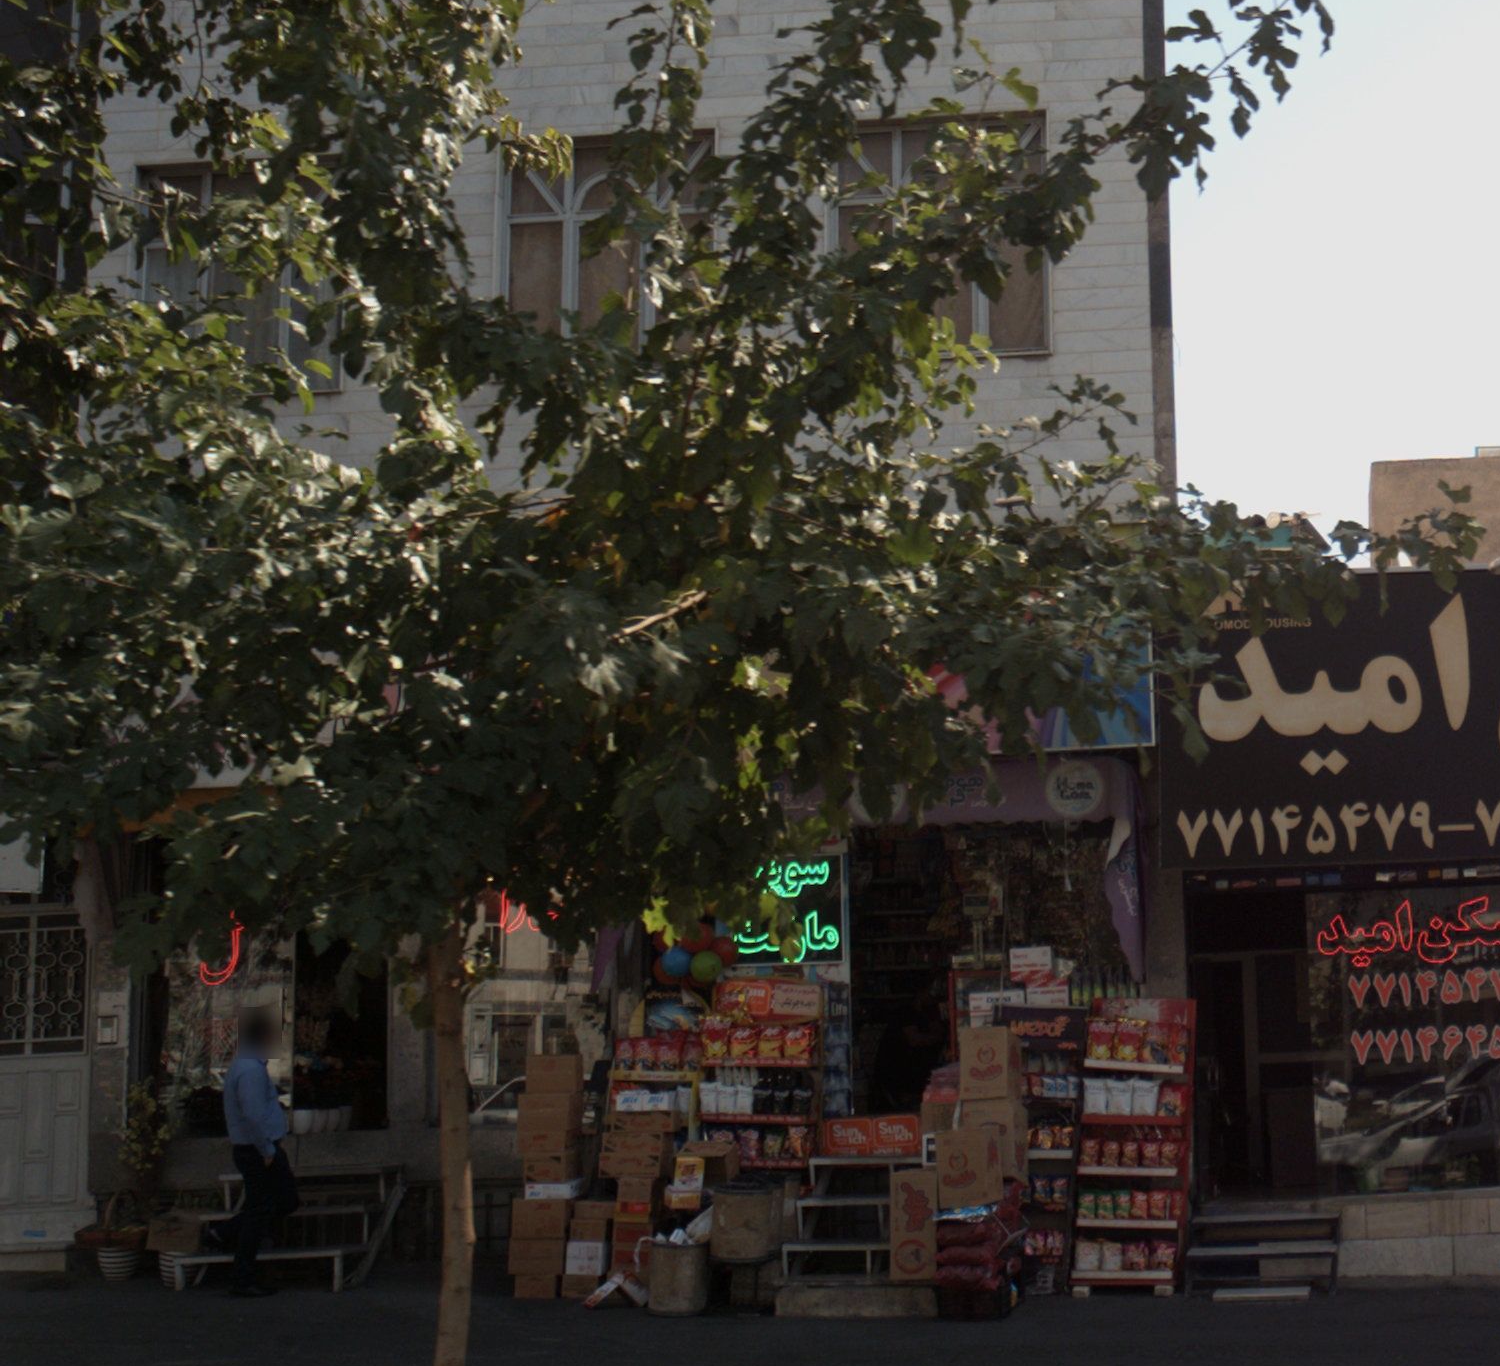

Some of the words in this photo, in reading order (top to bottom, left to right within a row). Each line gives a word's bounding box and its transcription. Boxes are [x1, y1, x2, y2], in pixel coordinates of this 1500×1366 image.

[1257, 617, 1311, 630] OUSING
[1199, 592, 1470, 777] امید
[735, 910, 840, 964] مارت
[1317, 898, 1413, 968] امید
